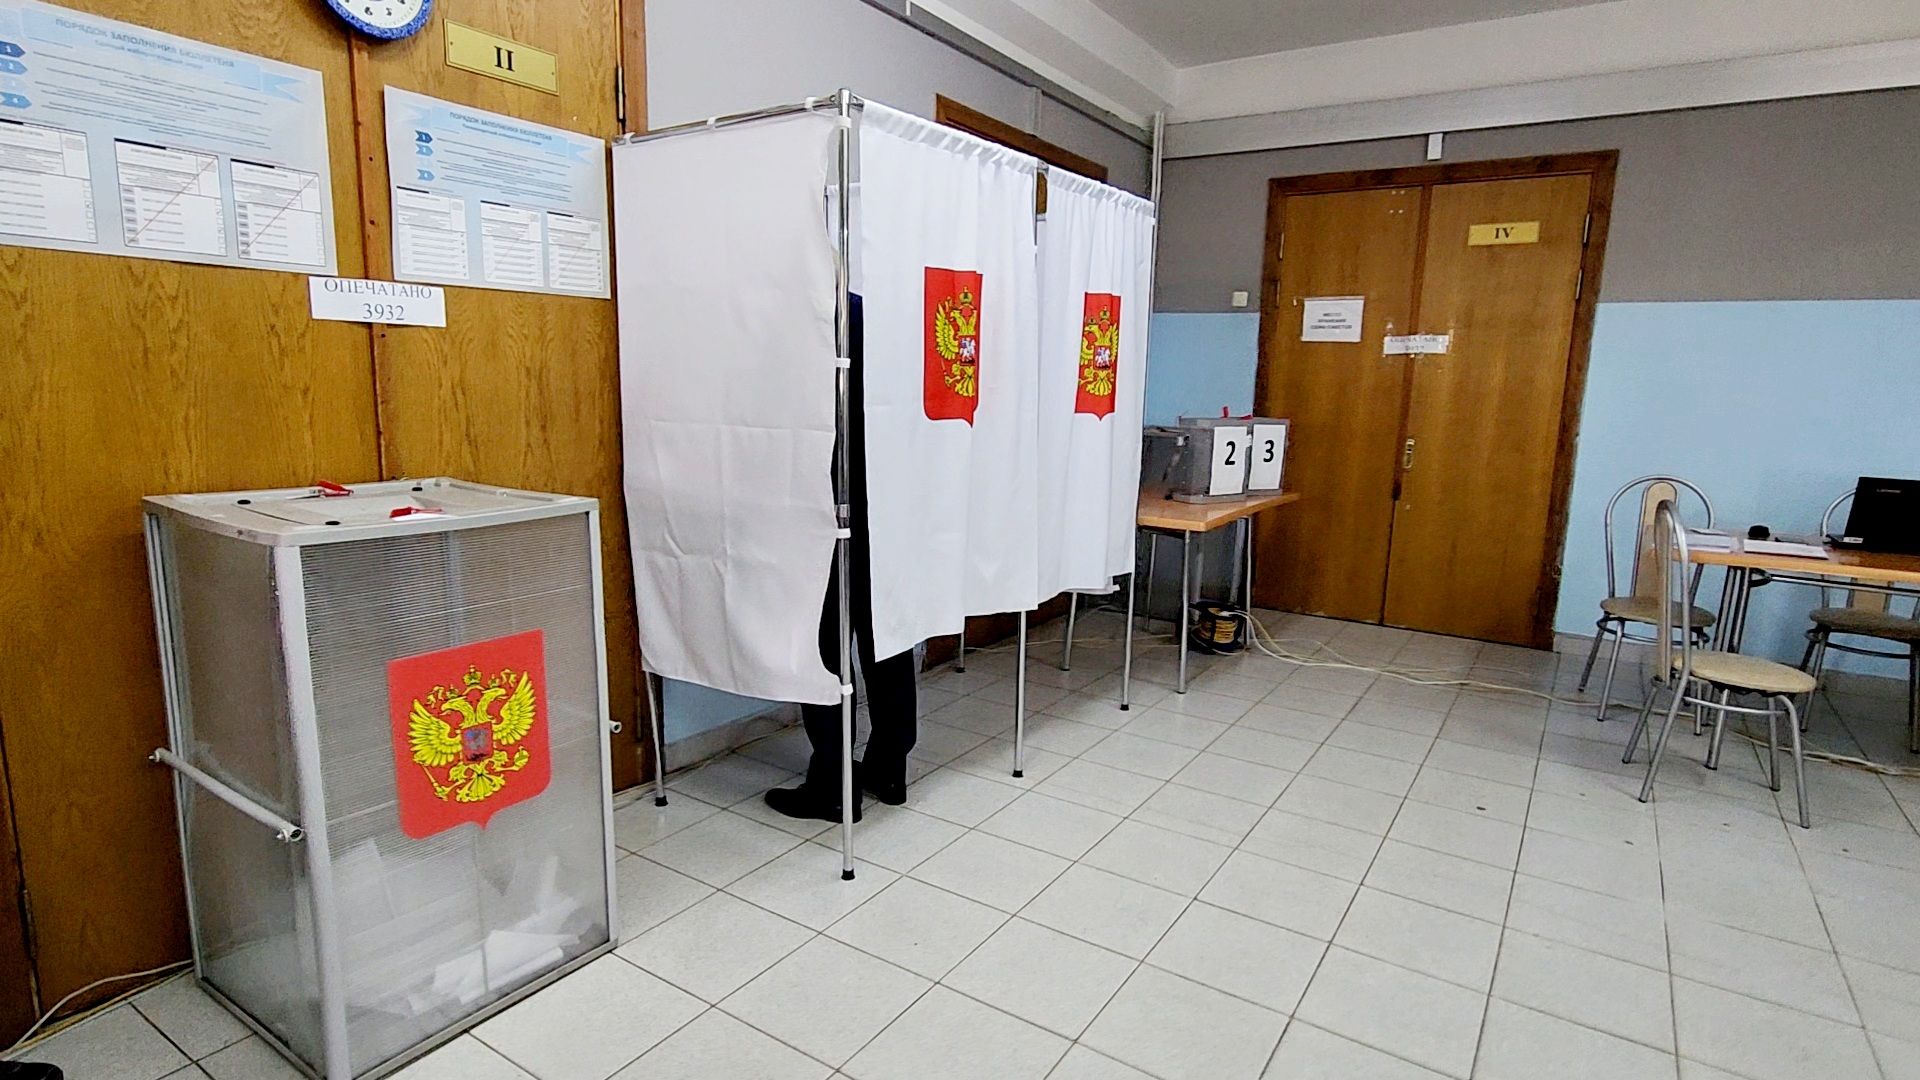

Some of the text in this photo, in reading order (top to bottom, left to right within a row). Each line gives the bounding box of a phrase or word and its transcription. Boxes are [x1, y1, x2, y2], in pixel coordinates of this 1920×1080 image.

[55, 18, 107, 37] ПОРЯДОК
[111, 32, 177, 53] ЗАПОЛНЕНИЯ
[494, 46, 515, 72] II
[1495, 227, 1514, 239] IV
[324, 278, 432, 299] ОПЕЧАТАНО
[362, 303, 404, 321] 3932
[1224, 441, 1236, 466] 2
[1263, 440, 1275, 463] 3
